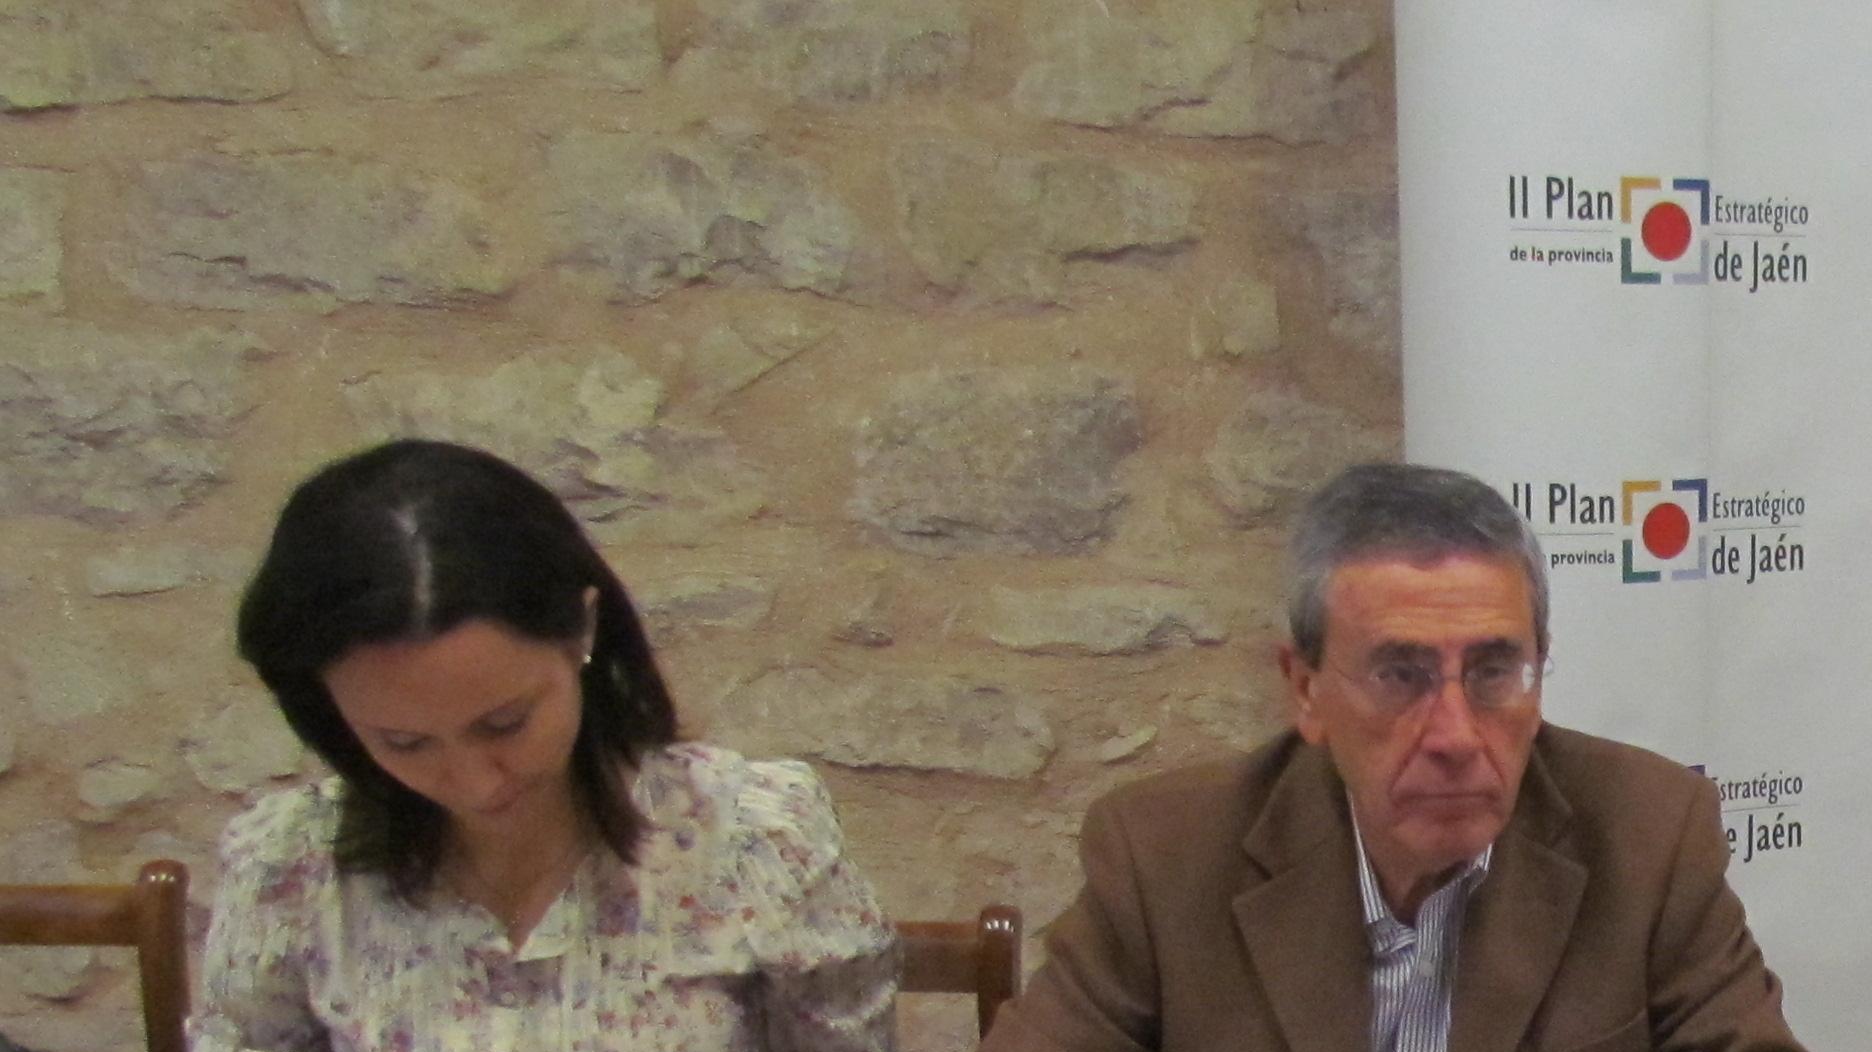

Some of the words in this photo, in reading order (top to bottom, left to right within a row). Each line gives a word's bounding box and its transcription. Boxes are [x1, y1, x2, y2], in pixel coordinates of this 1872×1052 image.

[1509, 176, 1528, 219] II
[1546, 176, 1613, 220] Plan
[1715, 195, 1808, 233] Estratégico
[1510, 247, 1527, 262] de
[1531, 247, 1544, 262] la
[1548, 248, 1614, 266] provincia
[1714, 240, 1742, 283] de
[1749, 241, 1807, 293] Jaén
[1549, 483, 1615, 524] Plan
[1712, 489, 1805, 524] Estratégico
[1551, 550, 1615, 569] provincia
[1712, 536, 1740, 575] de
[1746, 533, 1804, 585] Jaén
[1712, 770, 1803, 804] stratégico
[1726, 828, 1737, 853] e
[1744, 812, 1802, 863] Jaén
